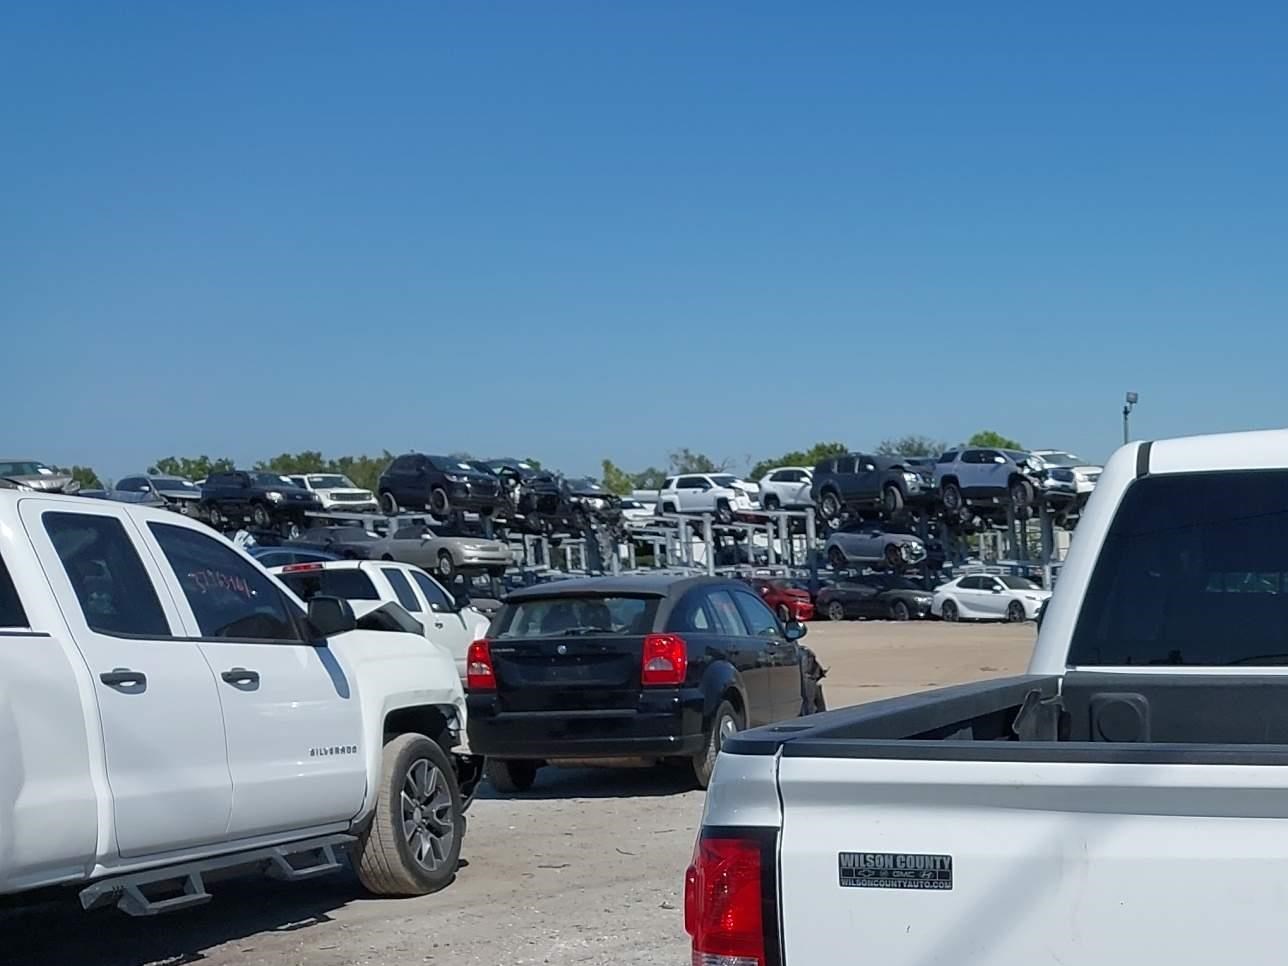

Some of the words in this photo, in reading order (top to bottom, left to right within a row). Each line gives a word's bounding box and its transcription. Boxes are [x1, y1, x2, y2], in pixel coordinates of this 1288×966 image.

[309, 744, 358, 757] SILVERADO
[840, 853, 894, 868] WILSON
[896, 855, 951, 870] COUNTY
[892, 870, 915, 878] GMC
[840, 878, 952, 889] WILSONCOUNTYAUTO.COM
